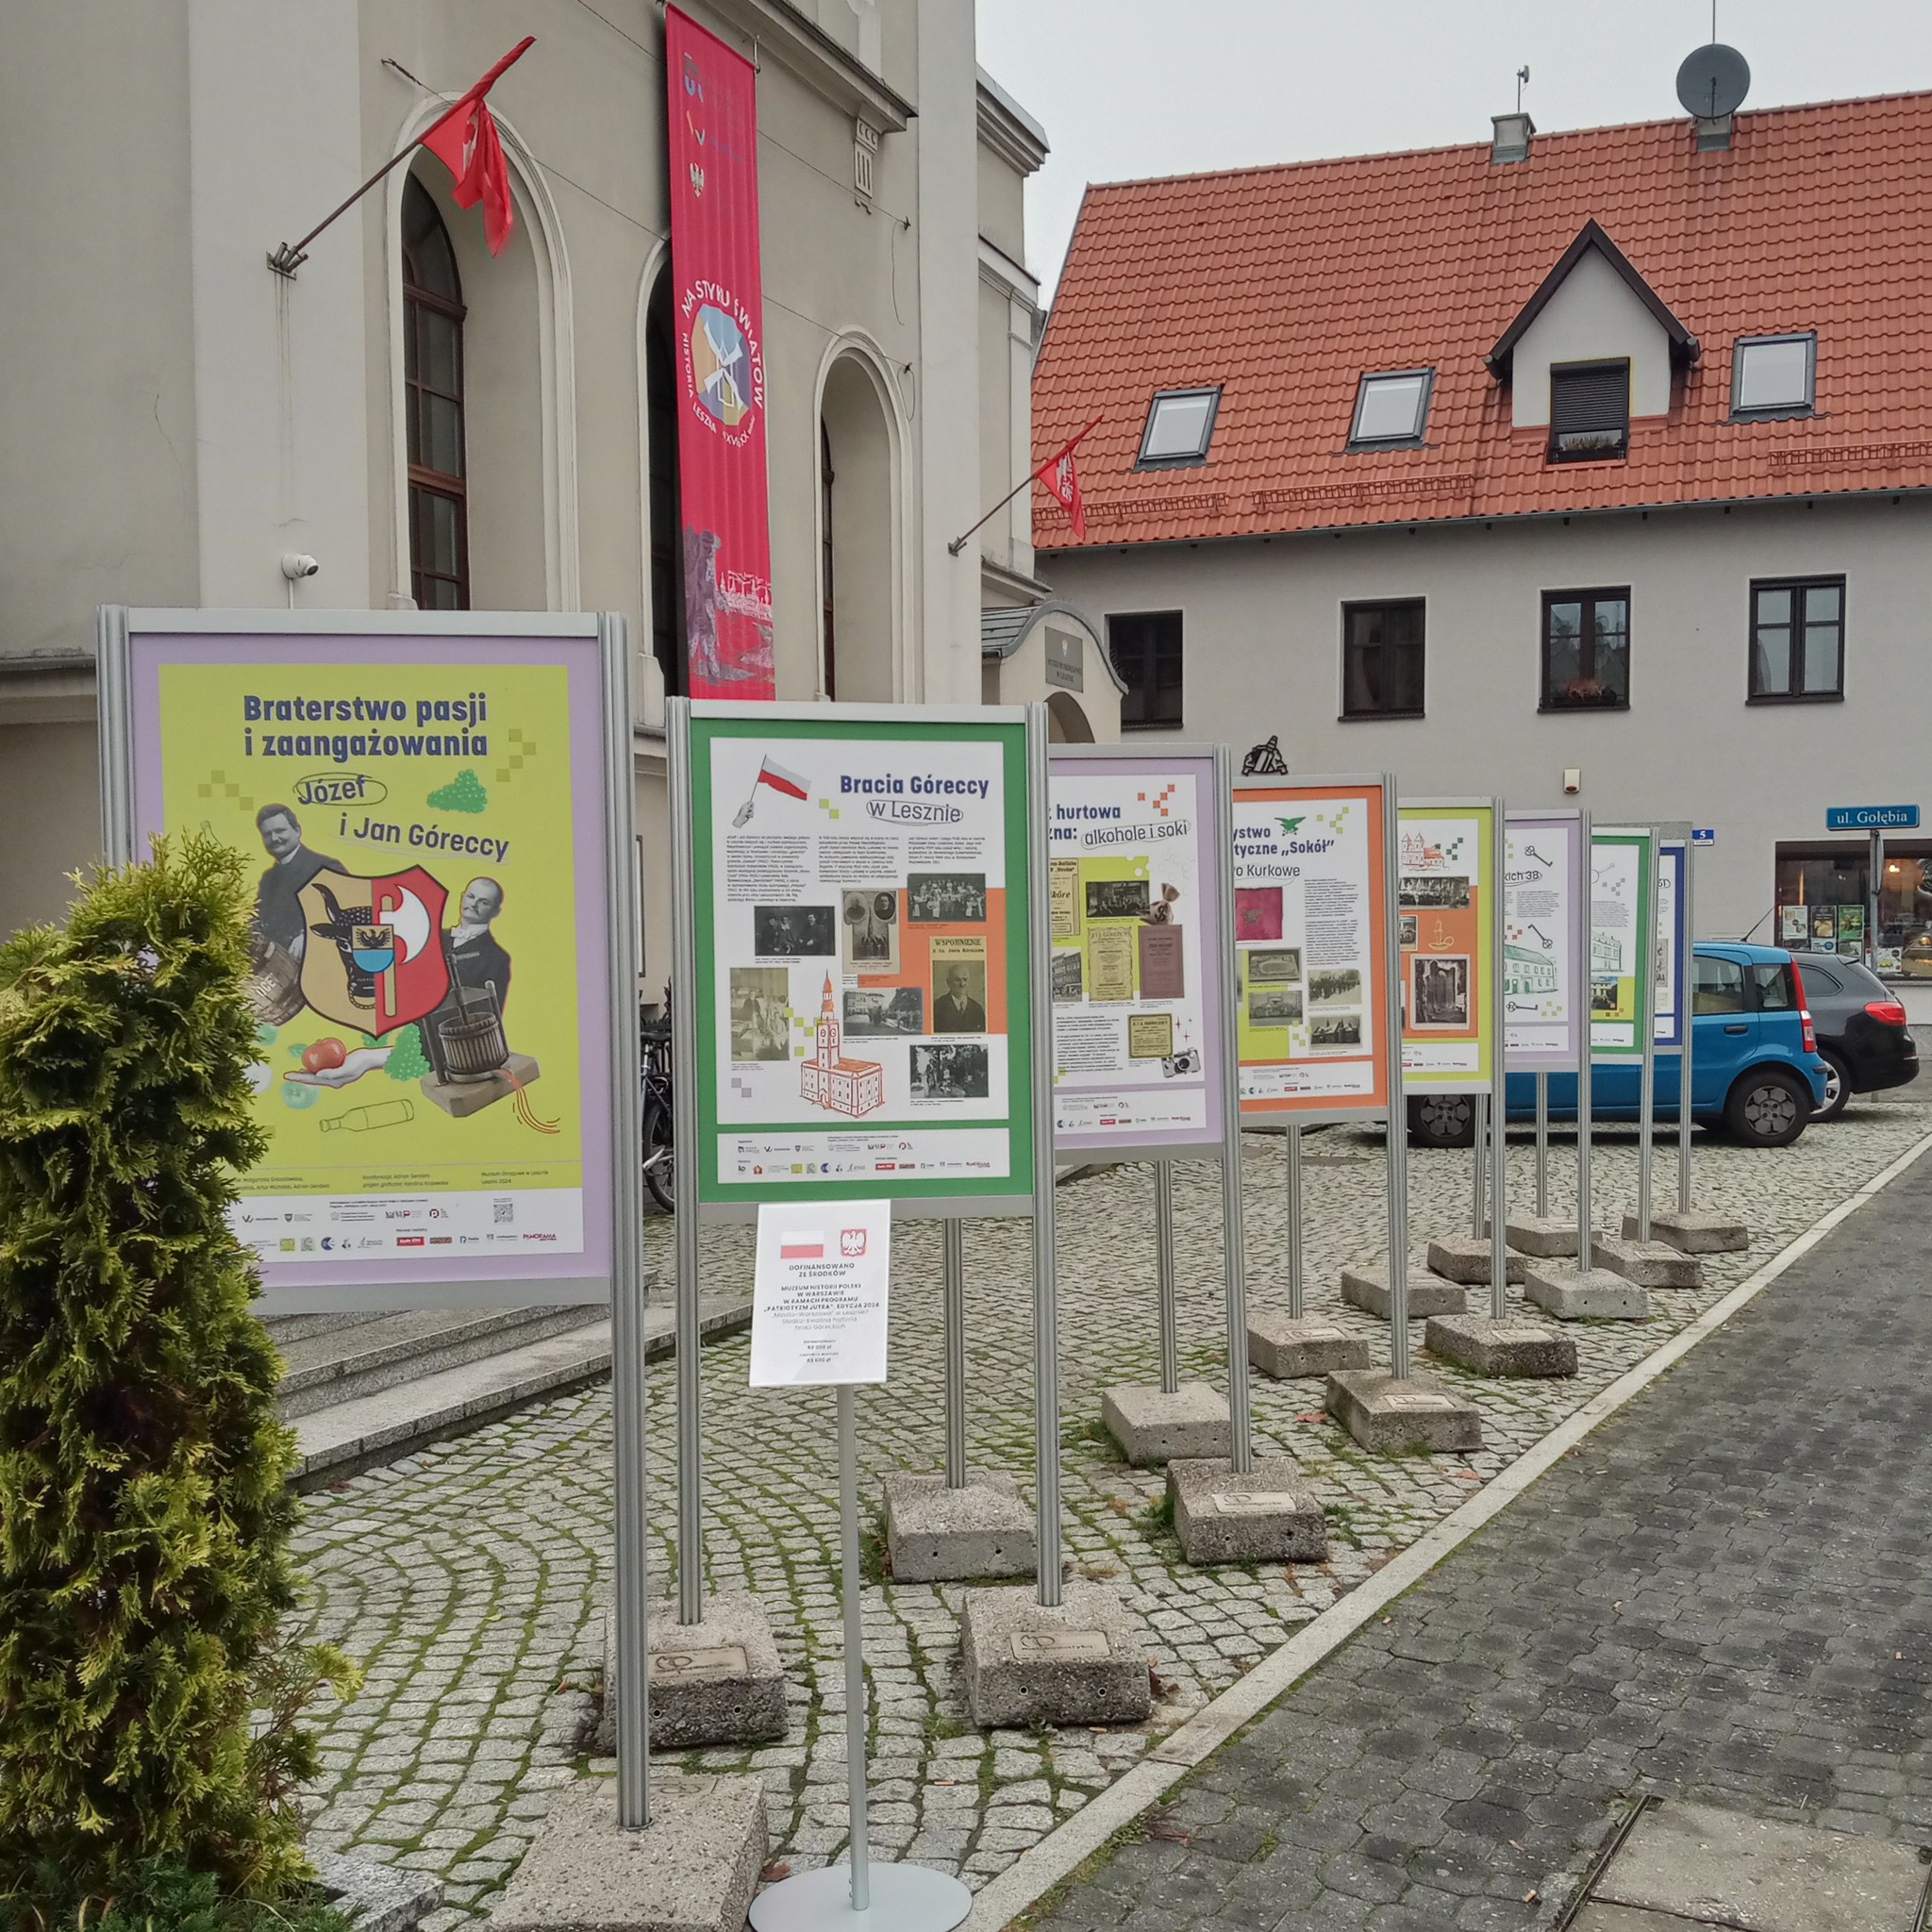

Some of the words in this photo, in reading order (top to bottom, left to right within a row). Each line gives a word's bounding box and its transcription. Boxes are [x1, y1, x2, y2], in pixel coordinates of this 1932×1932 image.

[681, 288, 697, 319] NA
[694, 279, 730, 308] STYKU
[682, 332, 694, 399] HISTORIA
[243, 694, 408, 722] Braterstwo
[416, 692, 488, 727] pasji
[244, 728, 252, 757] i
[262, 727, 488, 762] zaangażowania
[297, 774, 366, 806] Józef
[840, 774, 904, 795] Bracia
[910, 774, 990, 799] Góreccy
[869, 801, 887, 818] w
[891, 800, 961, 824] Lesznie
[1056, 804, 1122, 820] hurtowa
[1837, 811, 1853, 824] ul.
[1857, 809, 1907, 825] Gołębia
[340, 812, 348, 838] i
[353, 818, 402, 845] Jan
[408, 824, 510, 863] Góreccy
[1084, 824, 1147, 845] alkohole
[1149, 824, 1155, 839] i
[1158, 820, 1189, 839] soki
[1699, 830, 1707, 840] 5
[1233, 865, 1243, 877] o
[1246, 864, 1301, 877] Kurkowe
[1525, 870, 1540, 880] 38
[789, 1262, 855, 1271] DOFINANSOWANO
